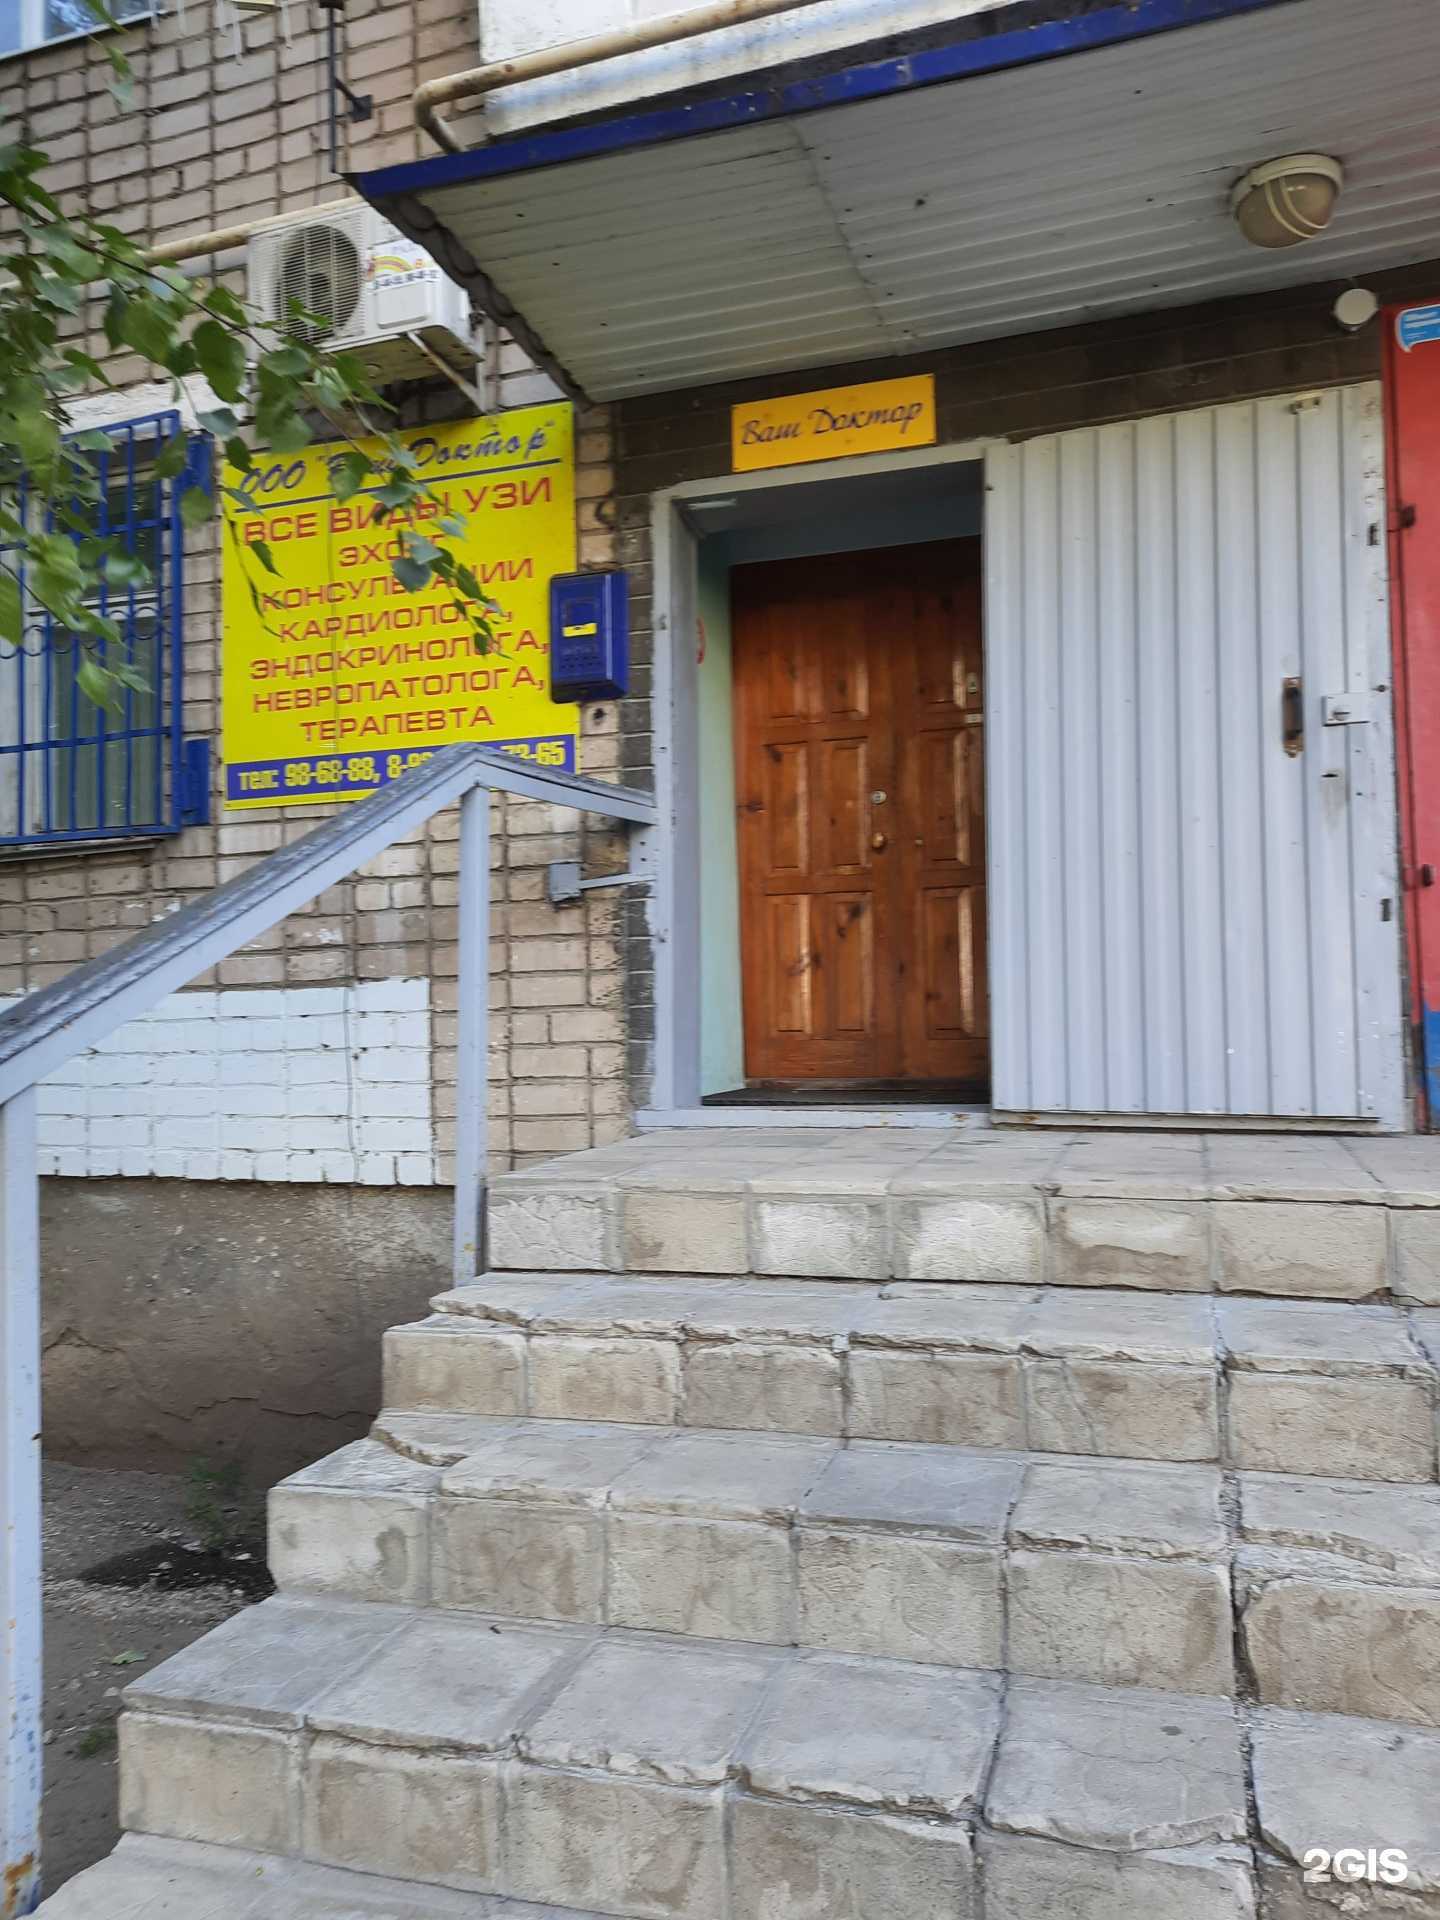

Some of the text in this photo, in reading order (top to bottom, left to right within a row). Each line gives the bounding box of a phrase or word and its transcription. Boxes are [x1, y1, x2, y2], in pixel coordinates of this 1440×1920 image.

[741, 401, 924, 445] Ваш Доктор
[244, 511, 319, 546] ВСЕ
[463, 476, 553, 513] УЗИ
[253, 665, 545, 714] НЕВРОПАТОЛОГА,
[300, 705, 495, 742] ТЕРАПЕВТА
